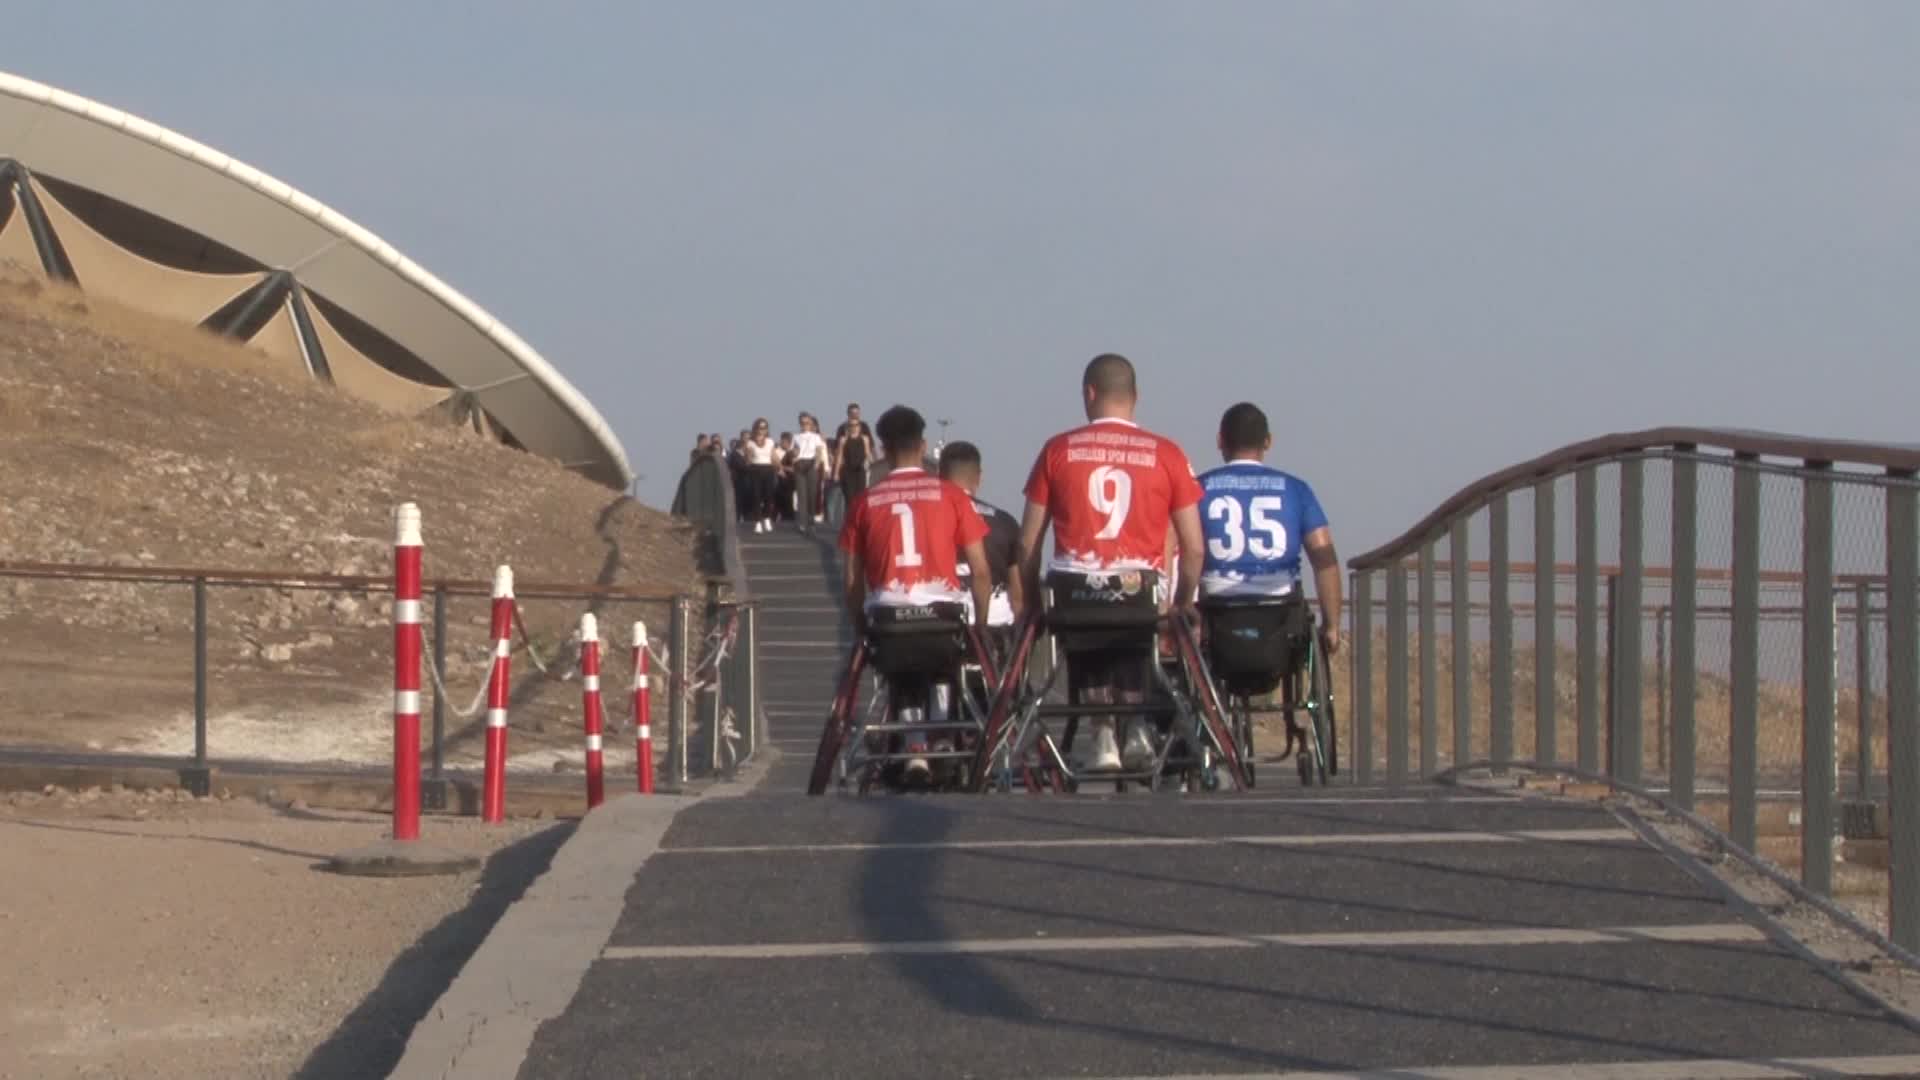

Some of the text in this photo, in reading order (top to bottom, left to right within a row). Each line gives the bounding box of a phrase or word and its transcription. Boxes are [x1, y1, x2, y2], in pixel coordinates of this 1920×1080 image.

[891, 503, 922, 567] 1
[1088, 465, 1132, 539] 9
[1208, 495, 1287, 561] 35
